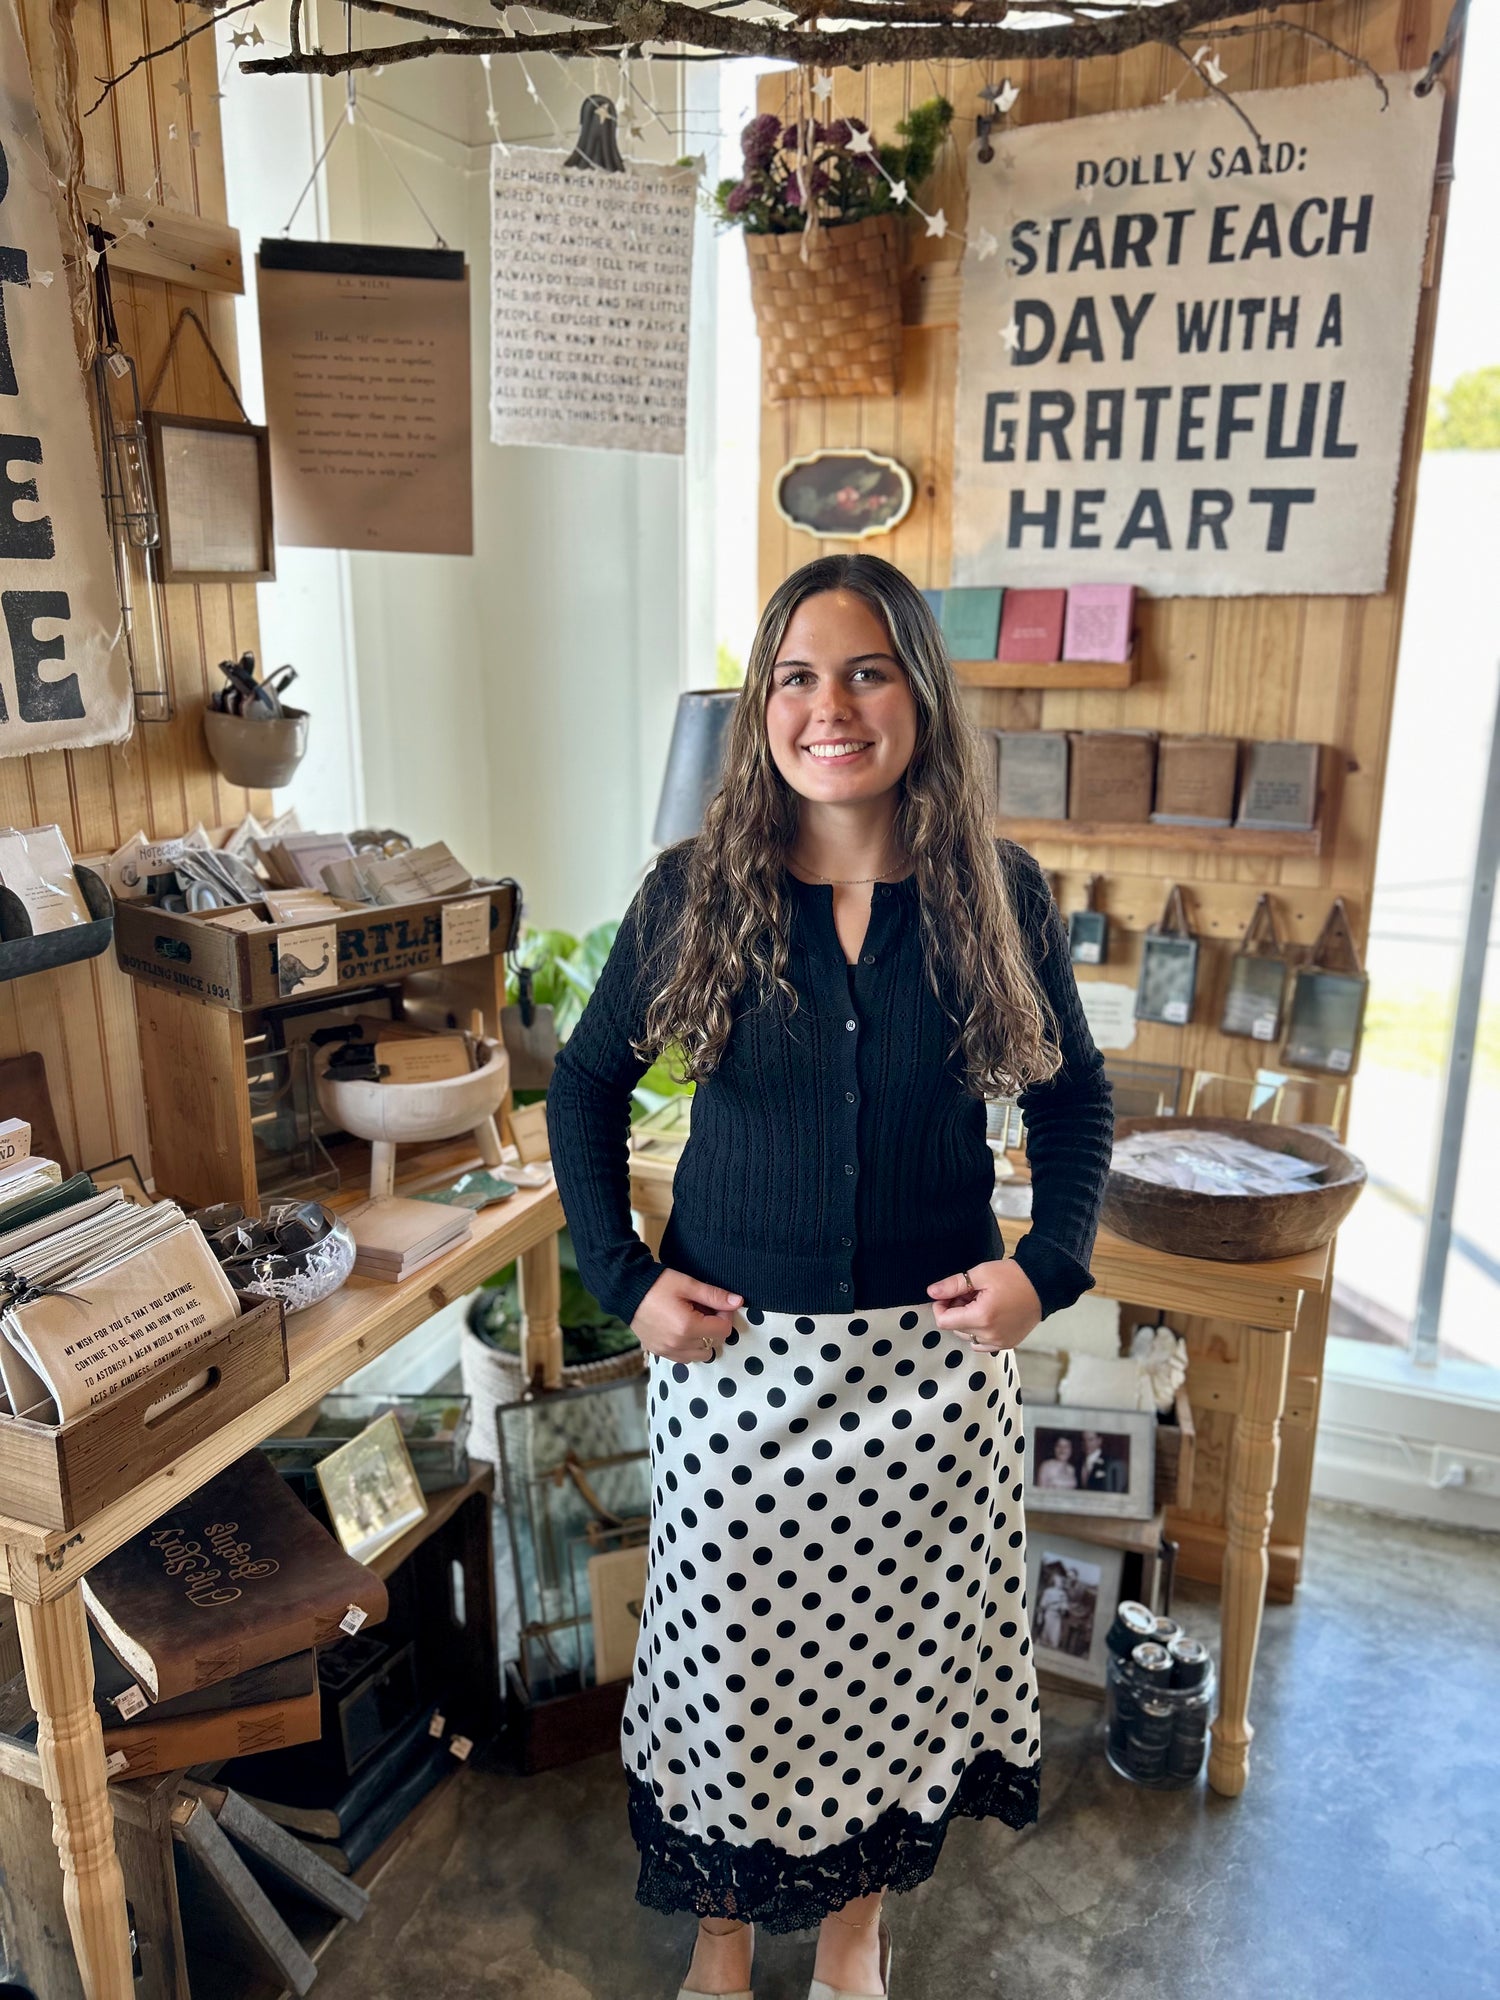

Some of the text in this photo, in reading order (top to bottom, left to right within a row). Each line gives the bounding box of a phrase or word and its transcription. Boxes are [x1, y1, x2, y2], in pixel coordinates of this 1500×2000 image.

[1075, 141, 1308, 190] DOLLY SAID:
[1009, 194, 1374, 276] START EACH
[1011, 292, 1343, 366] DAY WITH A
[982, 380, 1359, 463] GRATEFUL
[1006, 488, 1316, 552] HEART
[0, 590, 86, 724] E
[338, 949, 430, 981] OTTLING
[64, 1282, 196, 1356] MY WISH FOR YOU IS THAT YOU CONTINUE.
[74, 1349, 108, 1372] CONTINUE
[108, 1343, 119, 1354] TO
[119, 1337, 130, 1348] BE
[128, 1329, 144, 1342] WHO
[145, 1321, 158, 1334] AND
[158, 1313, 172, 1326] HOW
[172, 1306, 186, 1318] YOU
[84, 1314, 206, 1388] TO ASTONISH A MEAN WORLD WITH YOUR
[89, 1390, 108, 1406] ACTS
[109, 1383, 118, 1394] OF
[153, 1346, 182, 1368] CONTINUE
[183, 1340, 193, 1350] TO
[150, 1529, 211, 1576] Story
[204, 1522, 280, 1581] Begins
